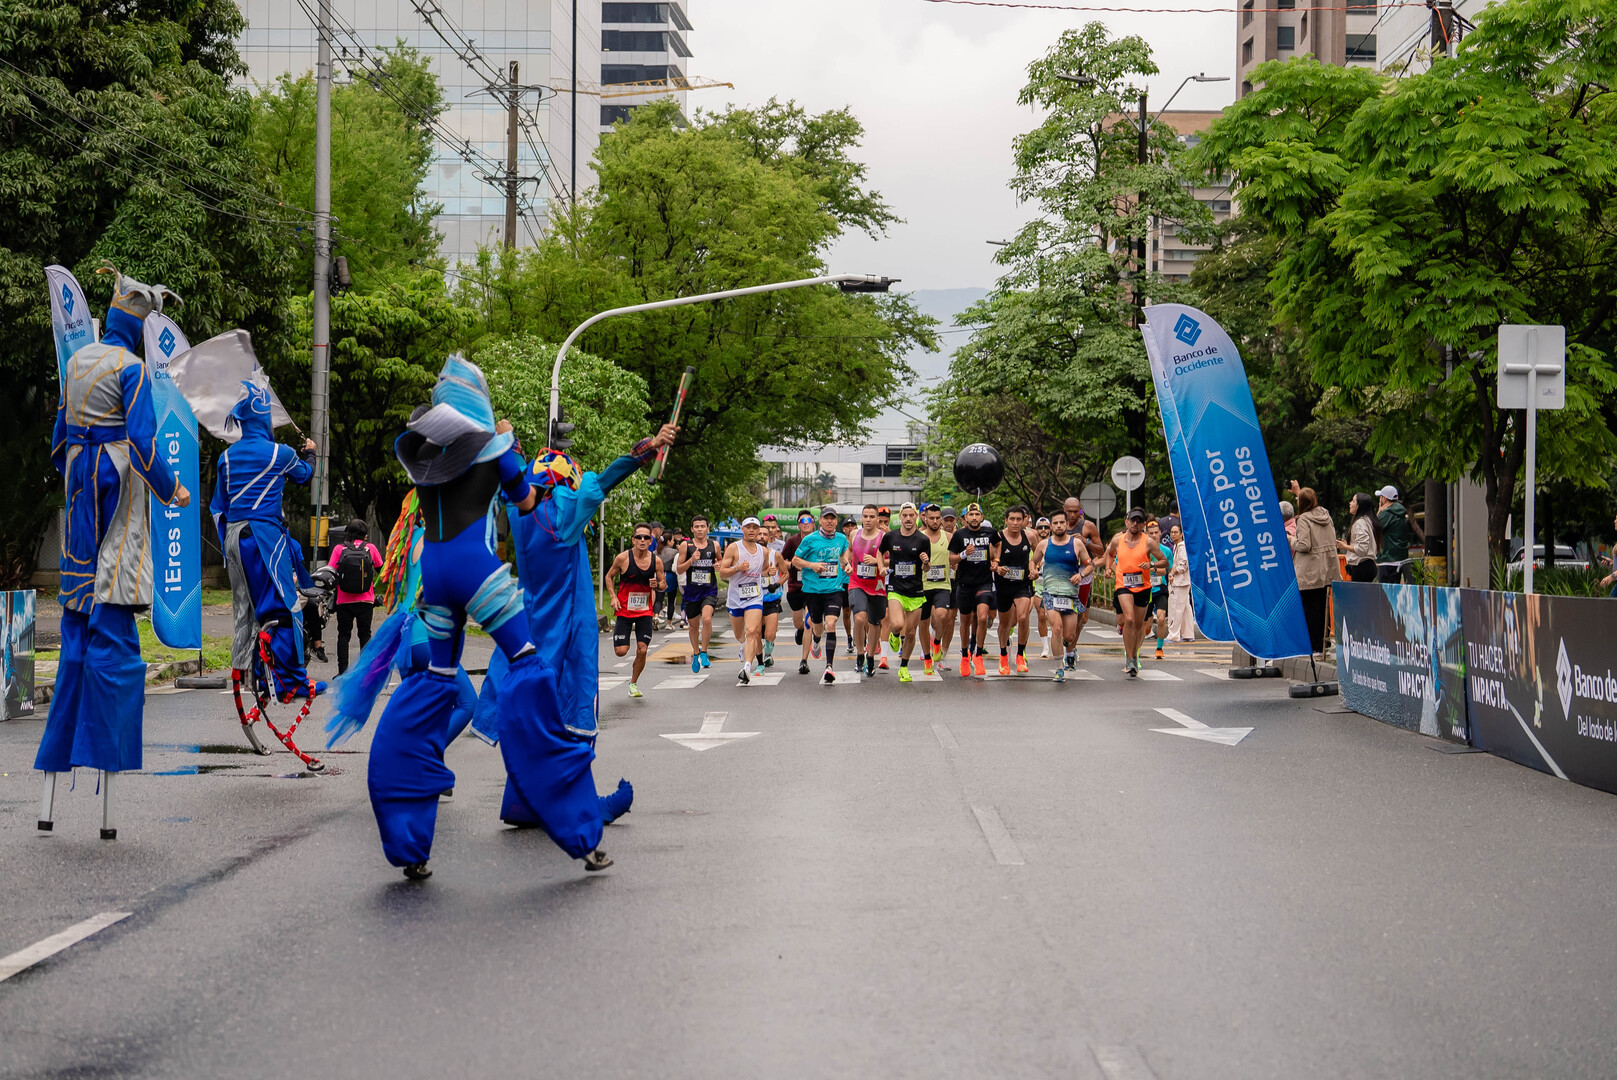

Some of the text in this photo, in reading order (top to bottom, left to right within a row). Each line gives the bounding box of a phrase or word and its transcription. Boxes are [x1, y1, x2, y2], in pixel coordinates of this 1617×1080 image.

[1173, 346, 1218, 365] Banco de
[1174, 357, 1224, 376] Occidente
[969, 446, 988, 454] 2:55
[1205, 449, 1252, 590] Unidos por
[1235, 446, 1278, 571] tus metas
[963, 537, 990, 547] PACER
[164, 527, 182, 593] ¡Eres
[1395, 640, 1405, 665] TU
[1468, 642, 1507, 679] TU HACER,
[1472, 675, 1509, 711] IMPACTA.
[1574, 664, 1617, 703] Banco de
[1577, 714, 1588, 737] Del
[1604, 719, 1613, 742] de
